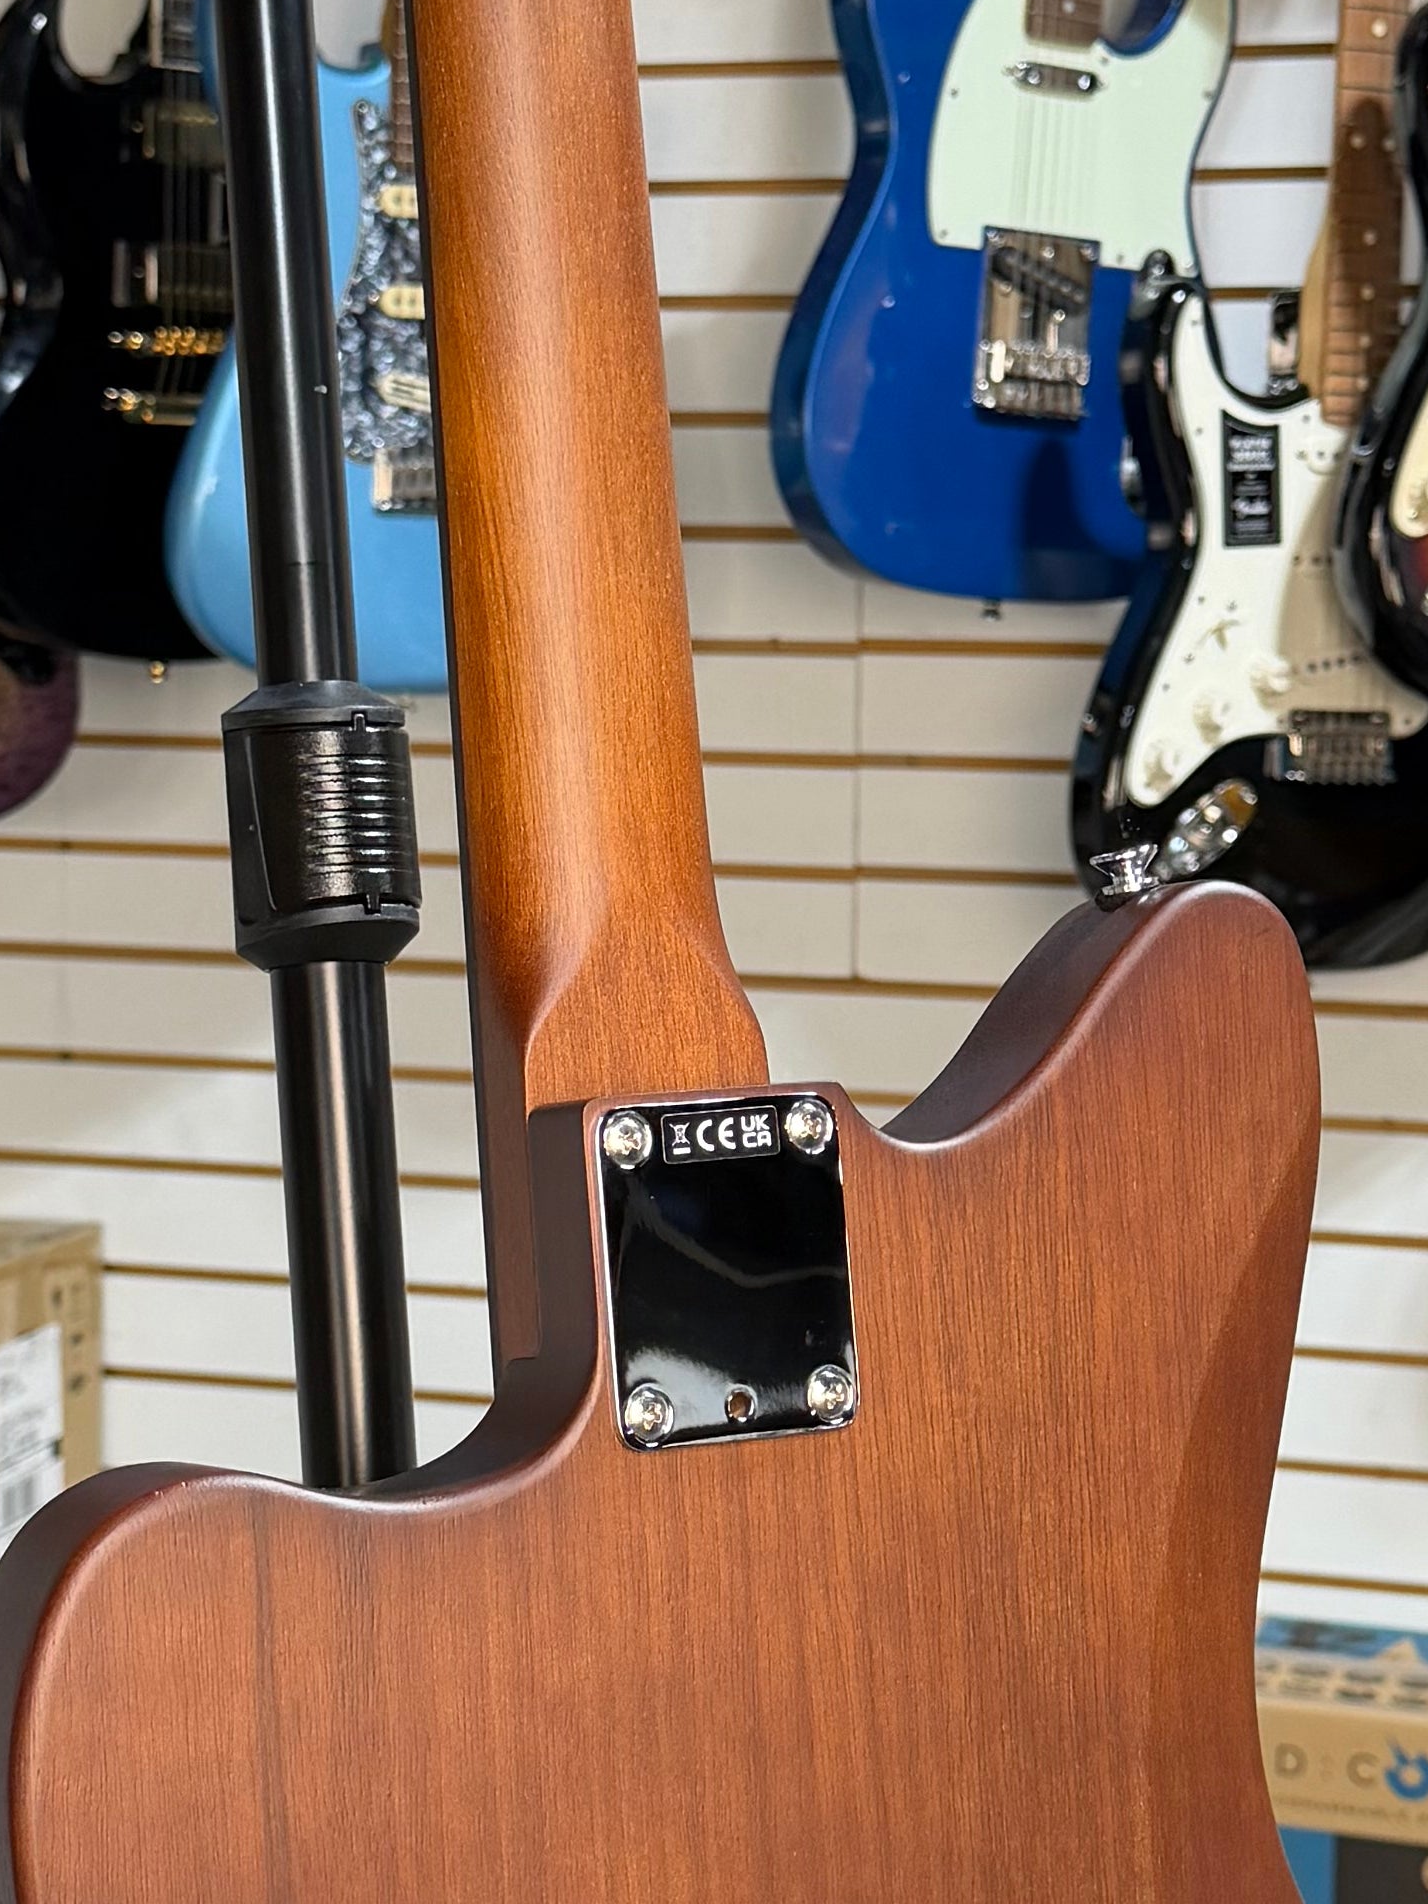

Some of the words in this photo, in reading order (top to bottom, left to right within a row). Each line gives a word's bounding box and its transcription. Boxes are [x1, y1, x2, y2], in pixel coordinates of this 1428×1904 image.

[740, 1114, 769, 1132] UK
[696, 1116, 737, 1153] CE
[741, 1130, 772, 1150] CA
